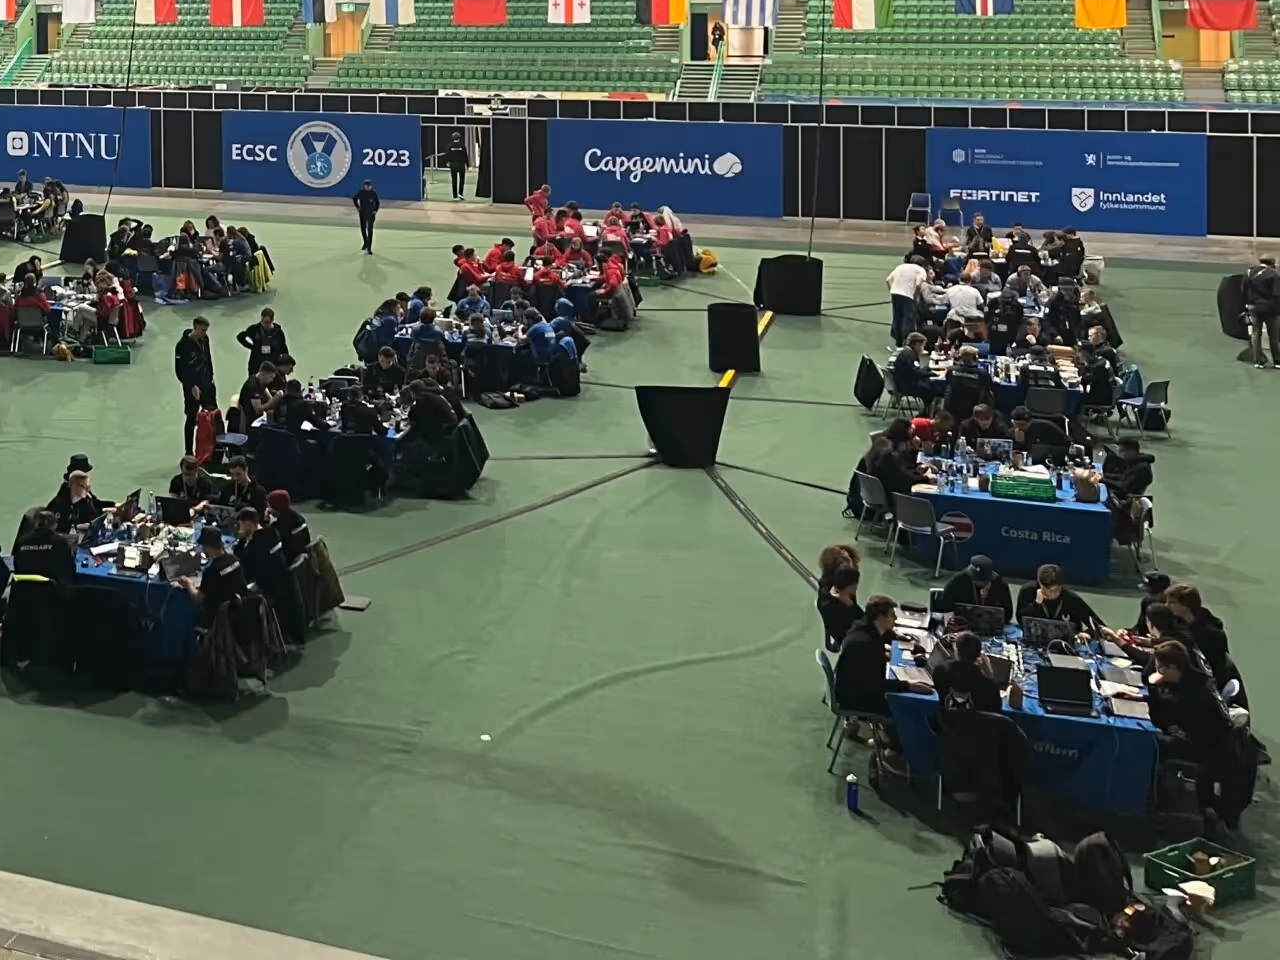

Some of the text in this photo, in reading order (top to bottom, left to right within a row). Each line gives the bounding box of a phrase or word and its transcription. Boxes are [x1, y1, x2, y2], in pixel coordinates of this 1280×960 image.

[32, 130, 120, 161] NTNU
[231, 143, 277, 162] ECSC
[362, 147, 411, 167] 2023
[584, 147, 712, 183] Capgemini
[1099, 190, 1166, 204] Innlandet
[1099, 200, 1166, 211] fylkeskommune
[1000, 525, 1070, 544] Costa Rica
